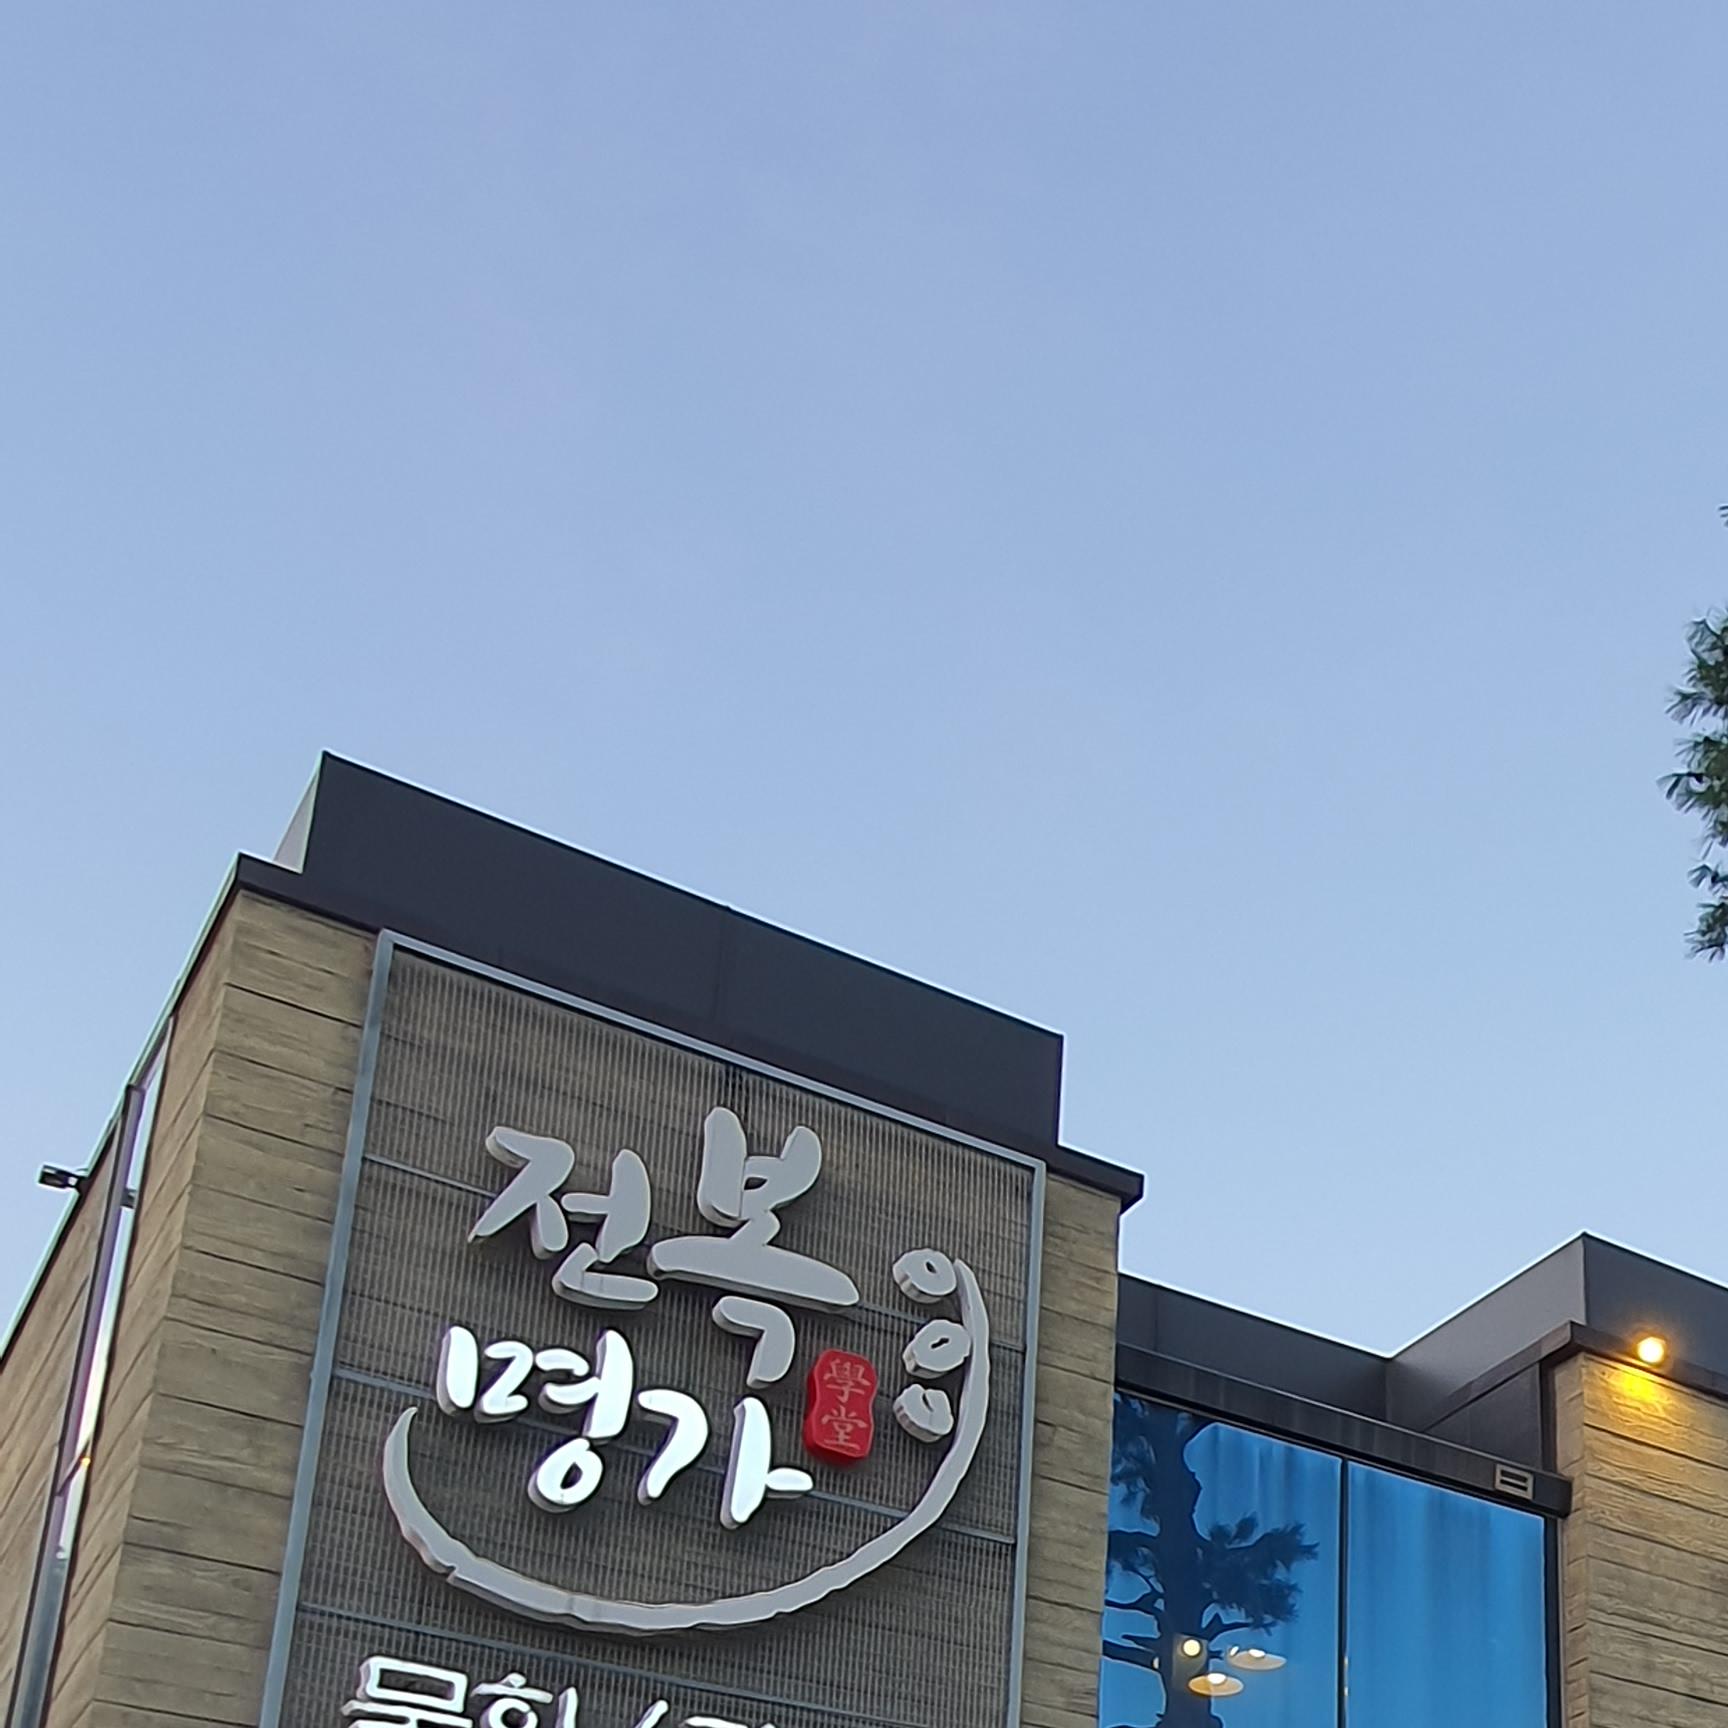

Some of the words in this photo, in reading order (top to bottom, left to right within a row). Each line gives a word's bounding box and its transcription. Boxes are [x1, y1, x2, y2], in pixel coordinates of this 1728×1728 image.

[472, 1107, 860, 1386] 전복
[437, 1326, 813, 1528] 명가
[821, 1358, 872, 1450] 學堂
